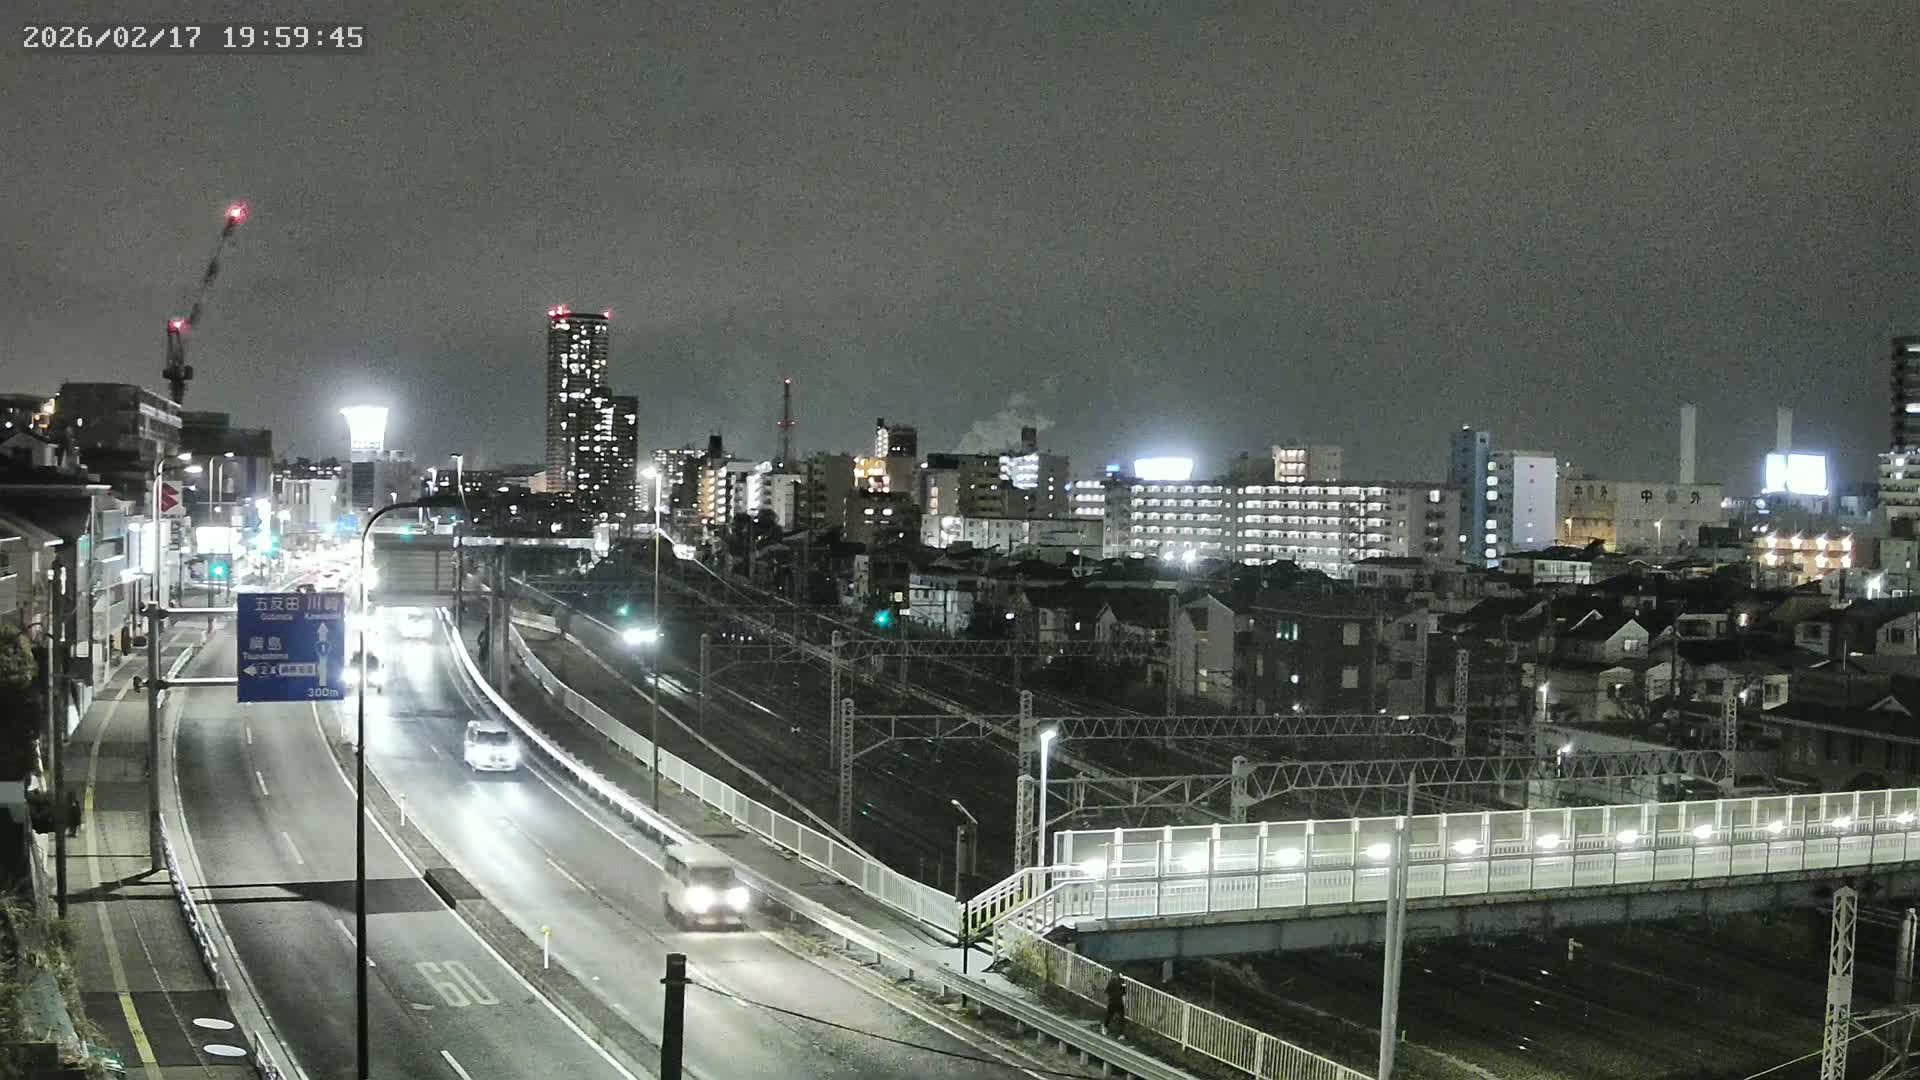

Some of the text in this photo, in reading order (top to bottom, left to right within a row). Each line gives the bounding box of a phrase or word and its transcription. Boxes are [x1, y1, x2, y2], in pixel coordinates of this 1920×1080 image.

[1641, 489, 1653, 503] 中
[254, 597, 300, 611] 五反田
[308, 688, 339, 697] 300m
[415, 960, 500, 1007] 60
